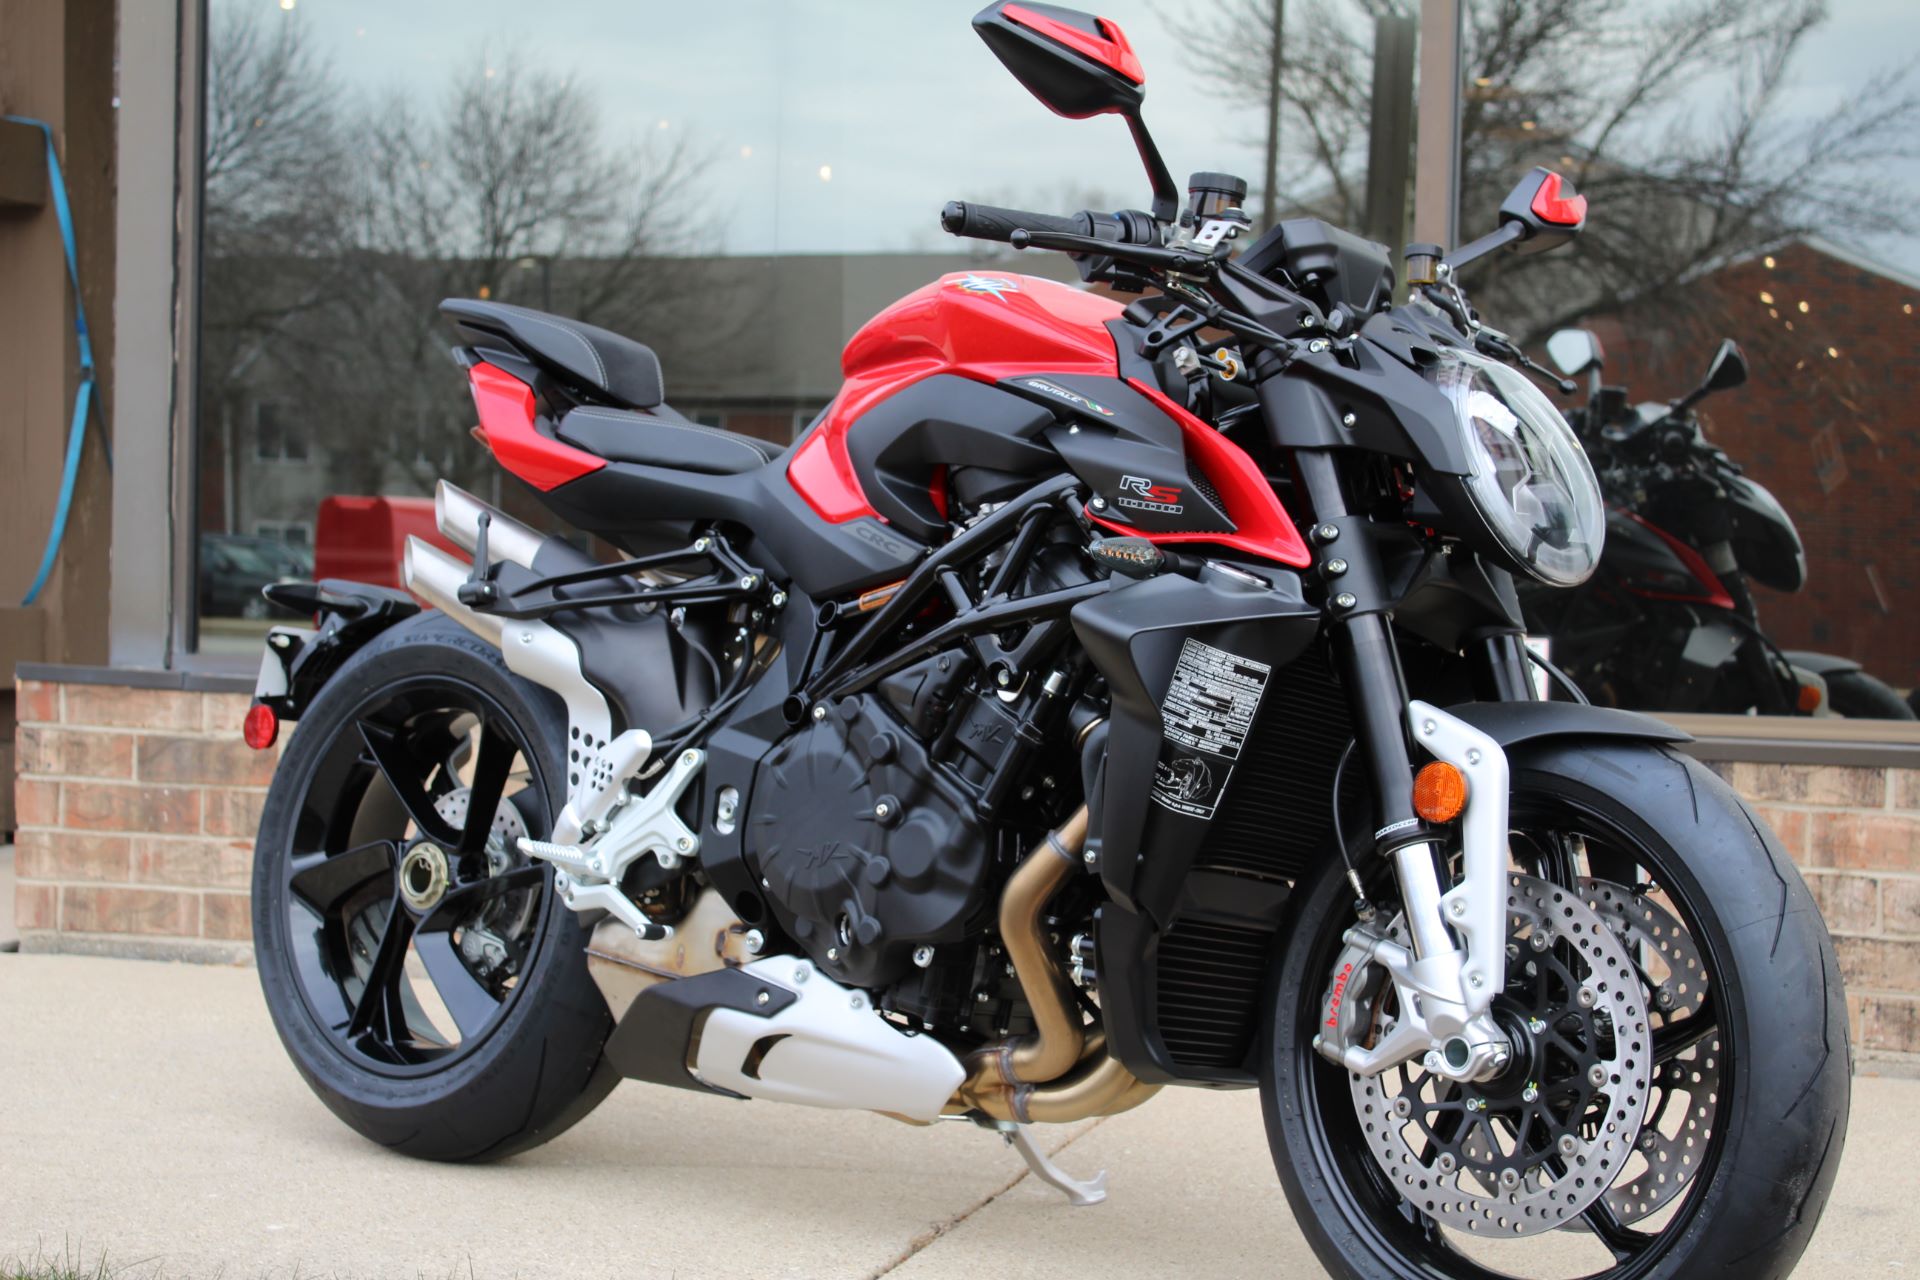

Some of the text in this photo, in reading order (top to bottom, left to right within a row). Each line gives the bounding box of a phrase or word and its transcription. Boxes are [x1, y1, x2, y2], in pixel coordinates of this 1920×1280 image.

[1027, 381, 1081, 403] BRUTALE
[1119, 474, 1183, 505] RS
[855, 526, 901, 554] CRC
[1324, 962, 1352, 1028] brembo
